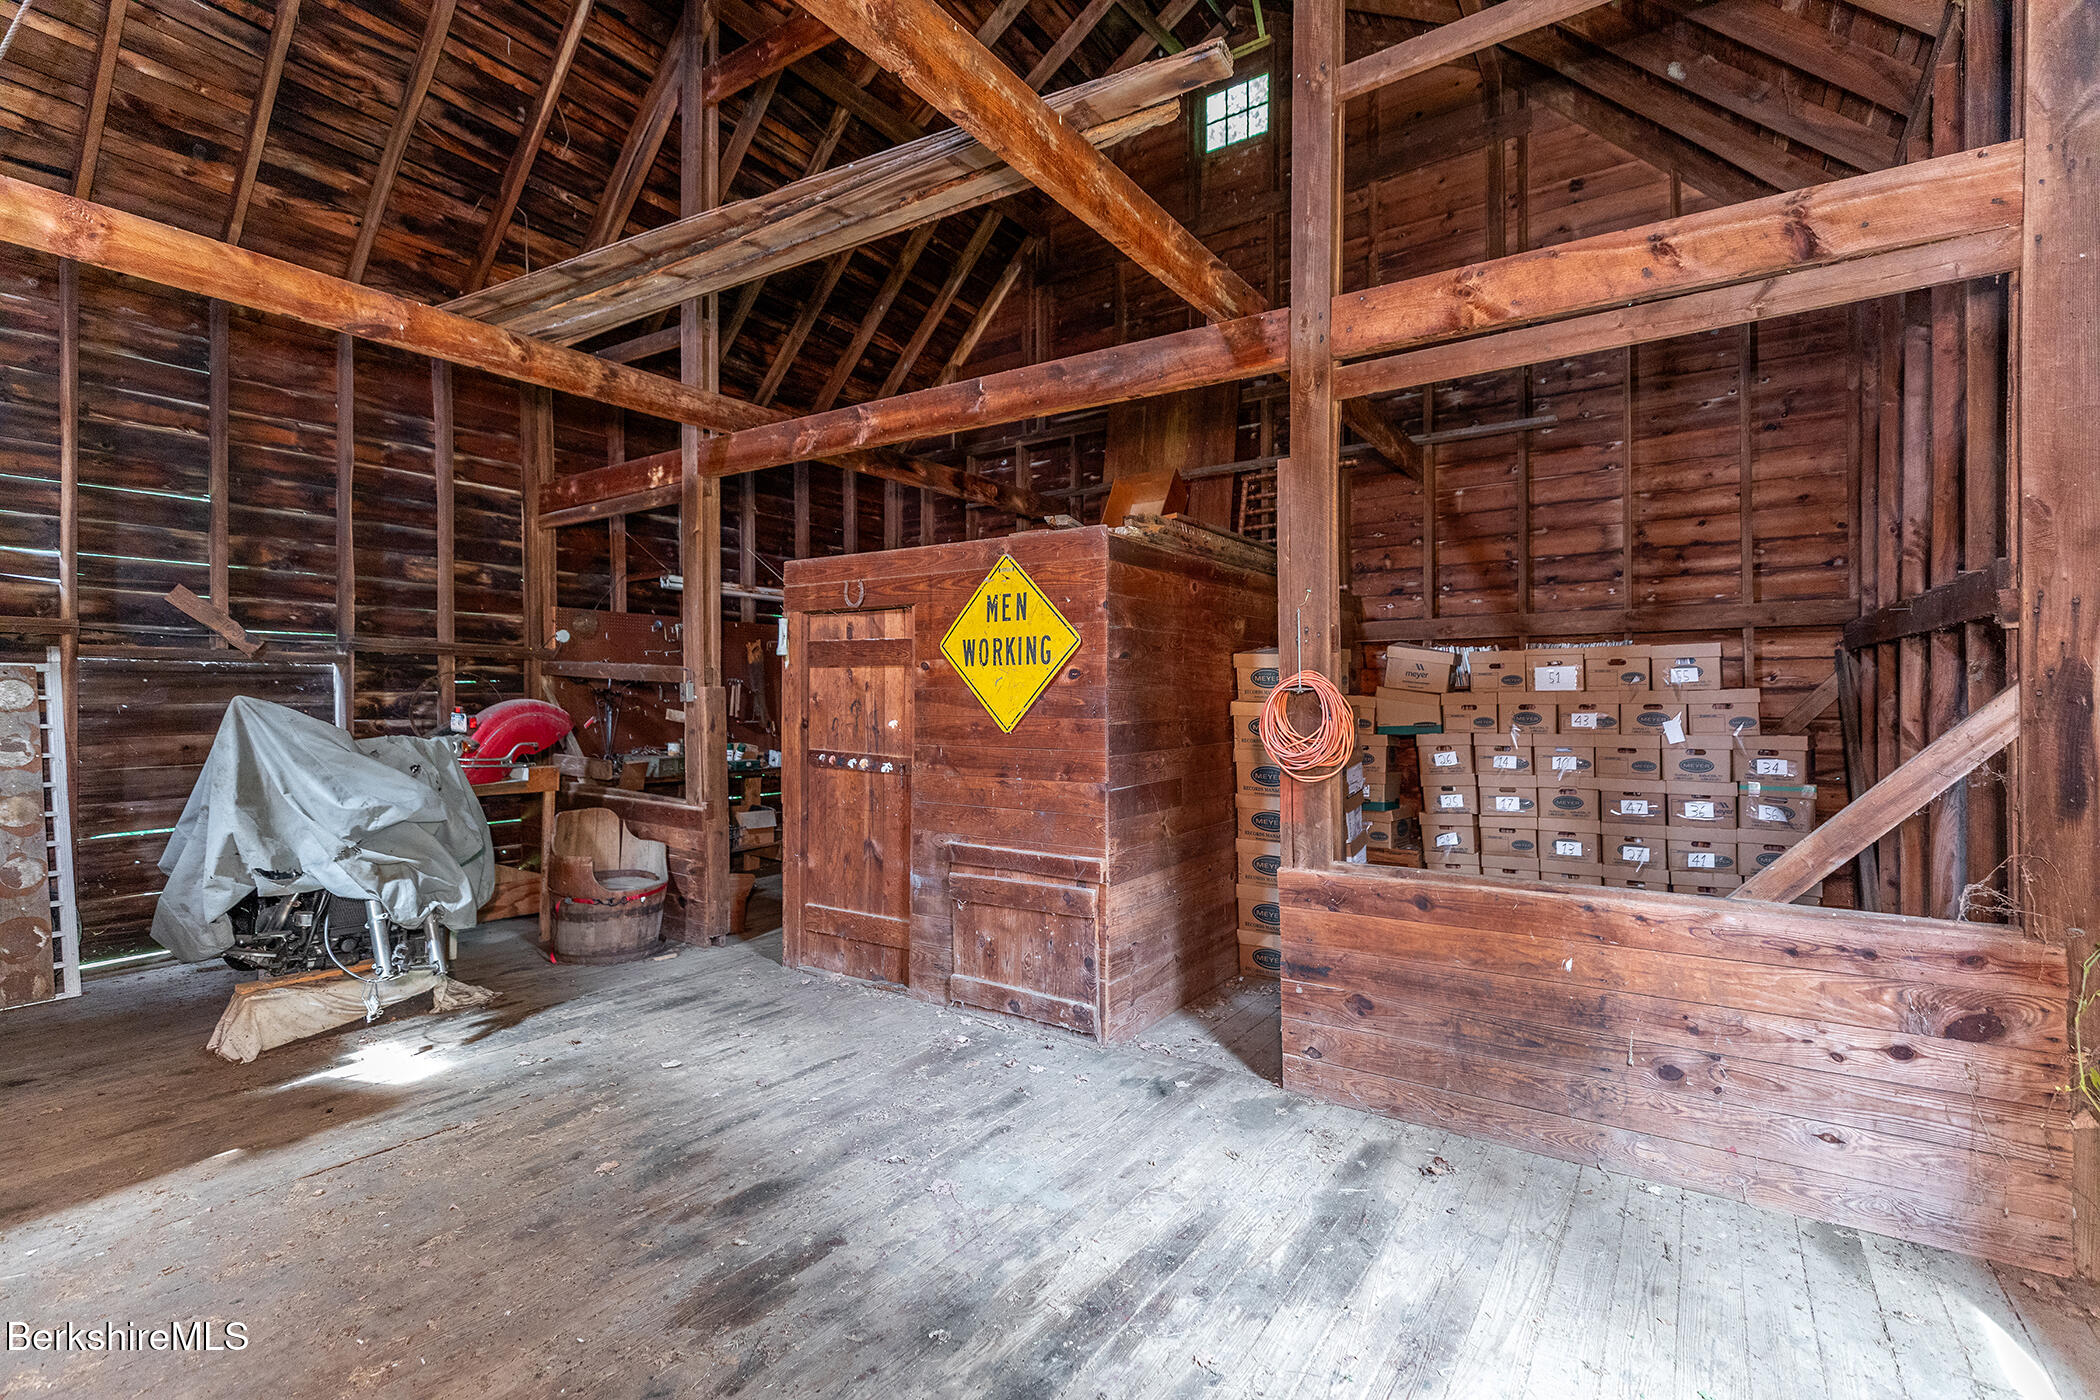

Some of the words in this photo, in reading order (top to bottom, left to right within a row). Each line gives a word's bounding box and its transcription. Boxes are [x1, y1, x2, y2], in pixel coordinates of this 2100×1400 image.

[986, 592, 1027, 623] MEN
[962, 634, 1052, 667] WORKING
[1405, 671, 1429, 680] meyer
[1549, 671, 1561, 684] 51
[1574, 715, 1589, 726] 43
[1439, 754, 1453, 765] 26
[1763, 762, 1780, 774] 34
[1444, 796, 1458, 807] 25
[1501, 798, 1514, 810] 17
[1626, 802, 1643, 814] 47
[1690, 804, 1705, 817] 36
[1764, 807, 1779, 817] 56
[1255, 818, 1280, 826] MEYE
[1561, 842, 1576, 855] 13
[1626, 848, 1644, 860] 27
[1255, 861, 1279, 870] MEYE
[1691, 854, 1707, 867] 41
[1255, 909, 1279, 918] MEYE
[1256, 955, 1279, 963] MEYE
